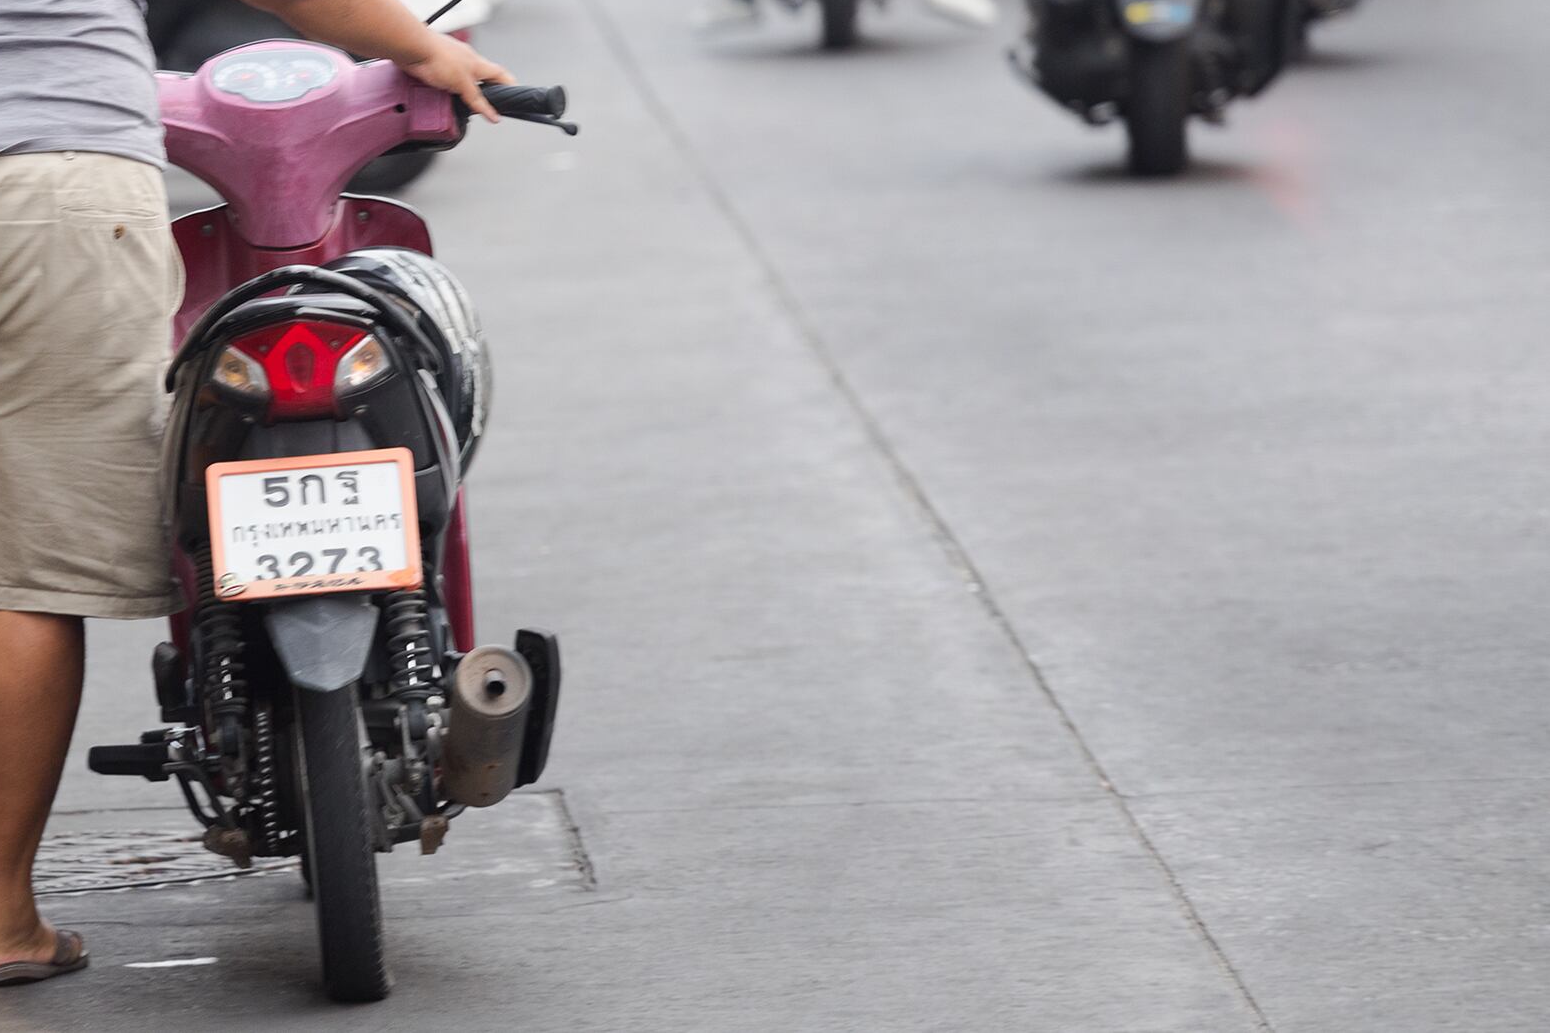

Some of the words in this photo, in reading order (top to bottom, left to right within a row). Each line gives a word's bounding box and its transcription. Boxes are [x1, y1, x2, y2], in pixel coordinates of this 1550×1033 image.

[232, 513, 402, 547] กรุงเทพมหานคร
[255, 546, 384, 582] 3273
